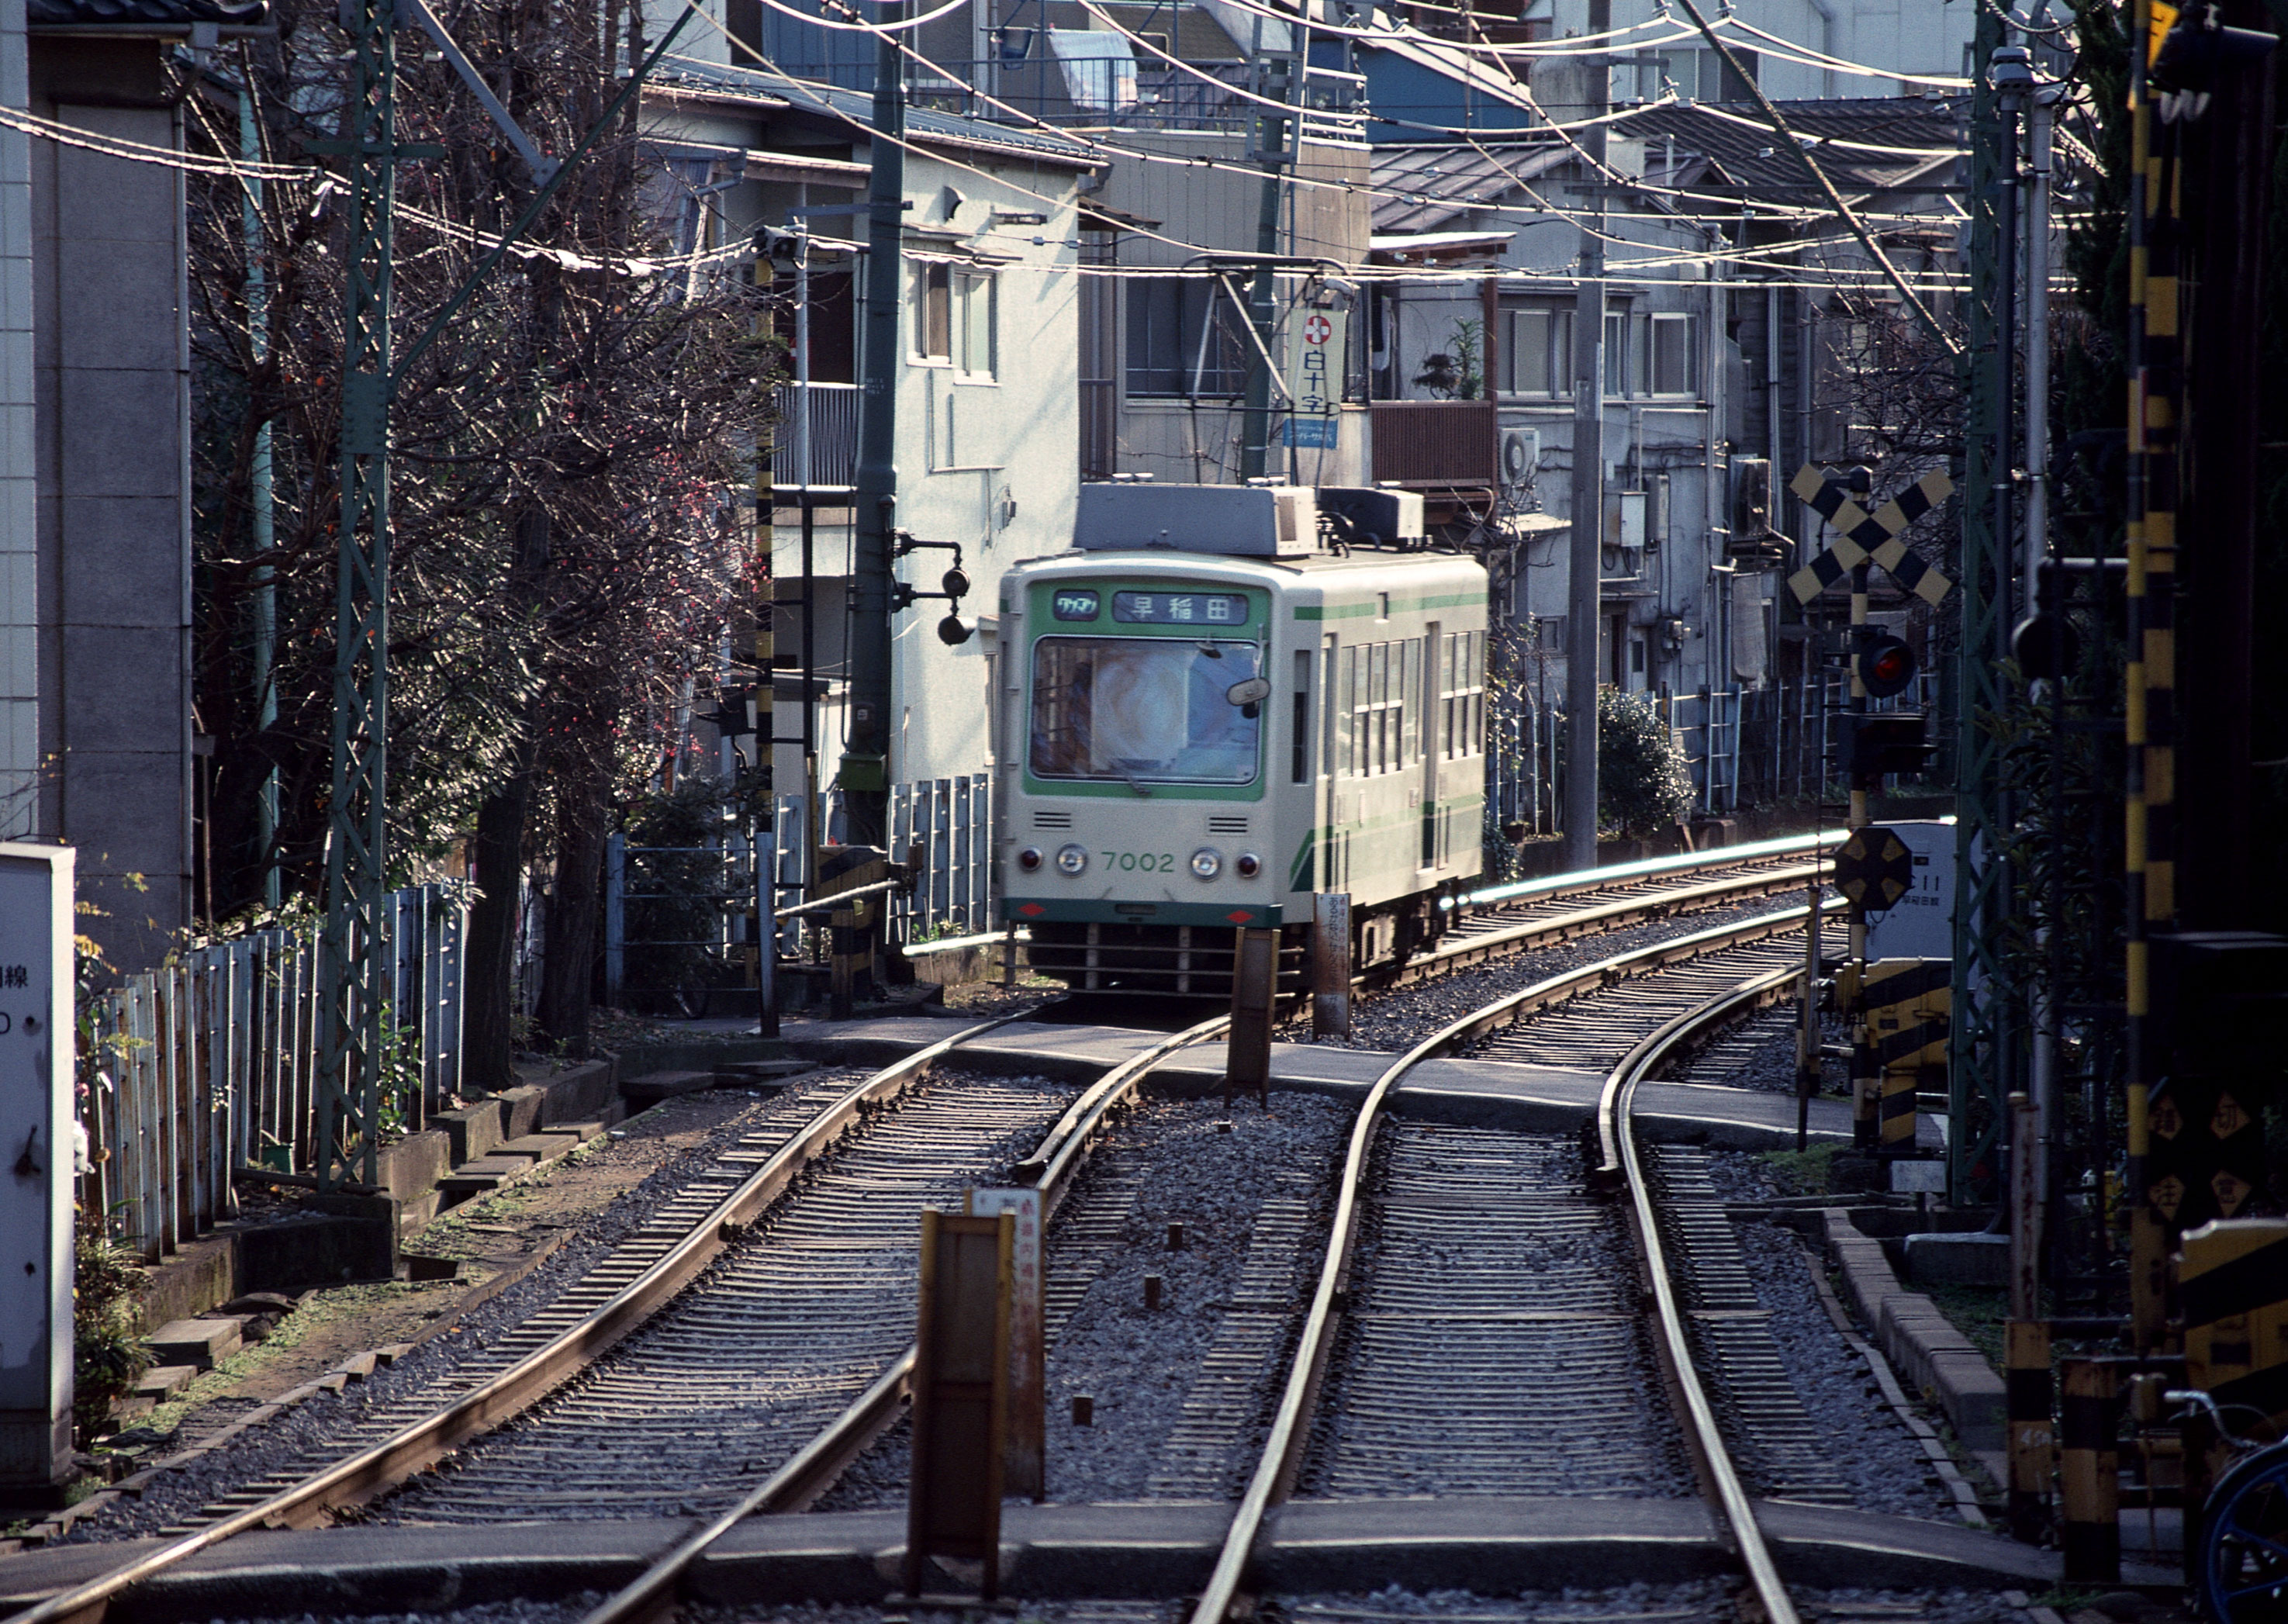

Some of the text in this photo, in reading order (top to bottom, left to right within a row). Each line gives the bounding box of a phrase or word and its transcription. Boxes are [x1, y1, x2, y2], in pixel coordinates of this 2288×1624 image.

[1301, 350, 1325, 412] 白十字
[1131, 596, 1229, 620] 早稲田
[1101, 852, 1175, 872] 7002
[0, 964, 28, 988] 線
